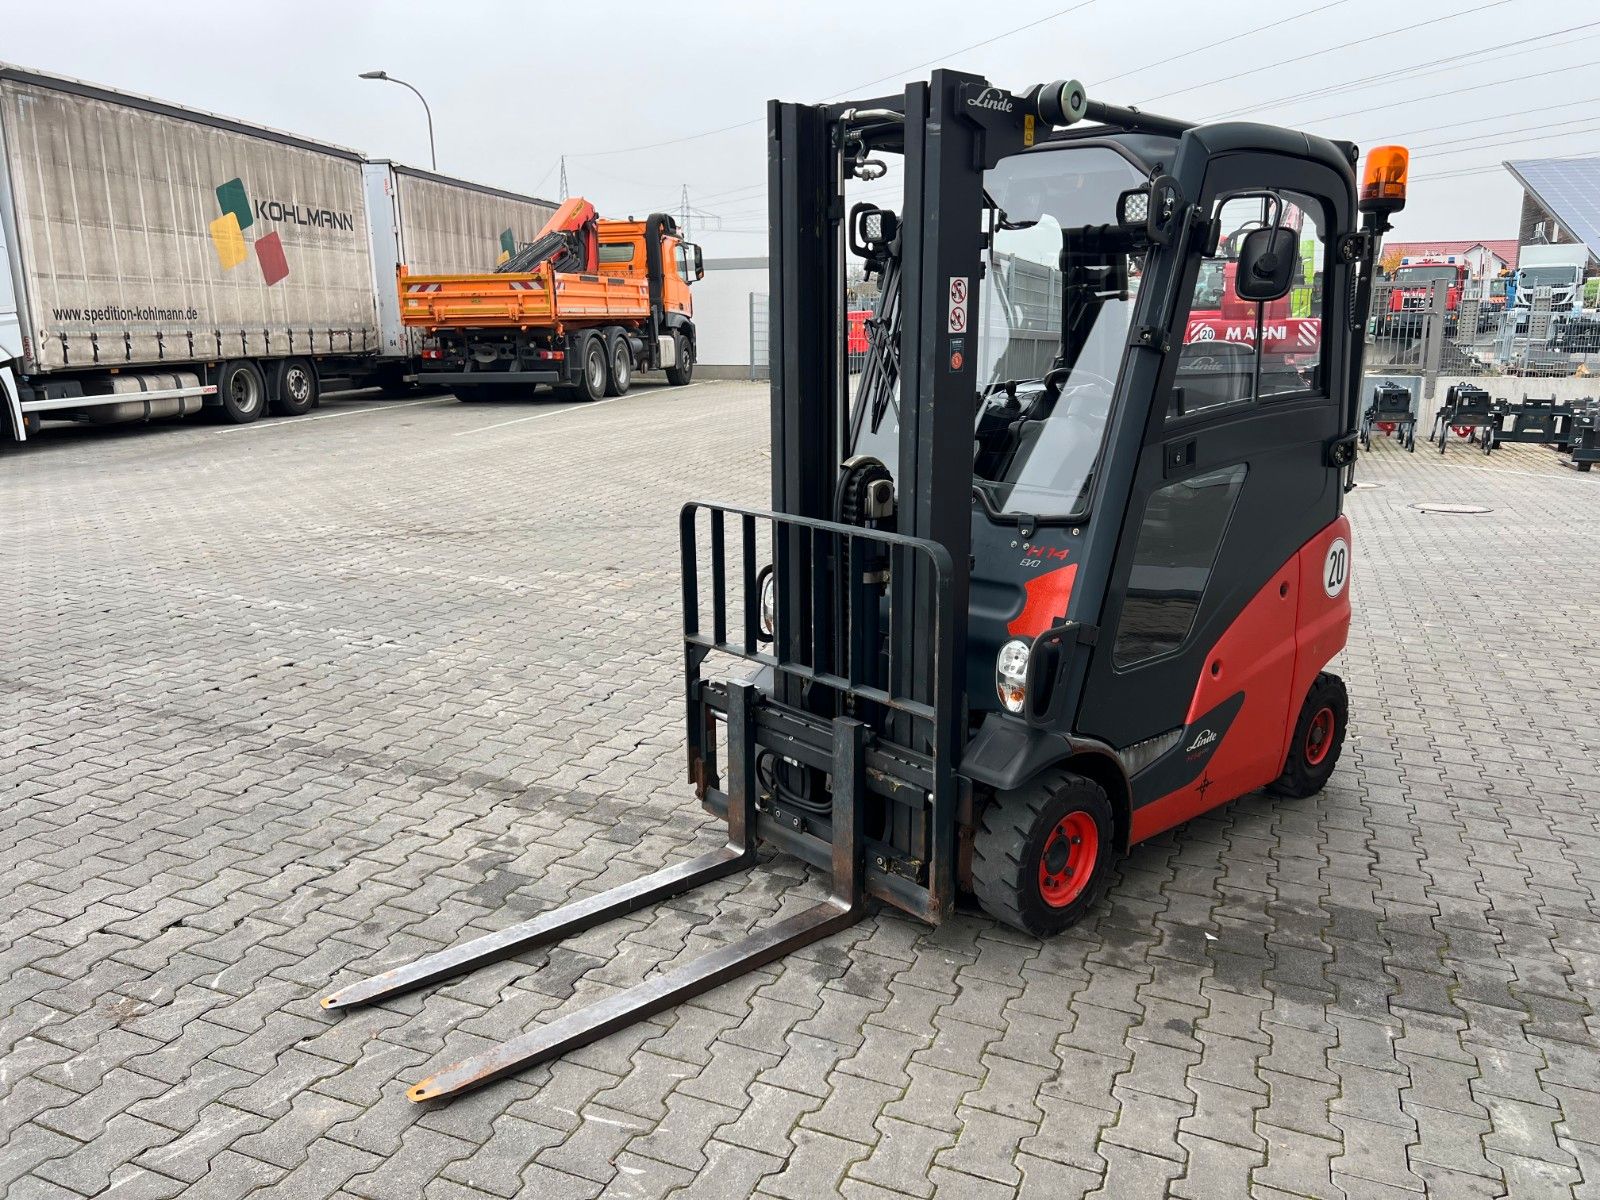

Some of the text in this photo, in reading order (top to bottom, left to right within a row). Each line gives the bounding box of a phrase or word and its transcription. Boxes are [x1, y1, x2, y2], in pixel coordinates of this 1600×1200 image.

[967, 87, 1013, 113] Linde
[254, 199, 354, 232] KOHLMANN
[52, 305, 198, 324] www.spedition-kohlmann.de
[1201, 329, 1214, 340] 20
[1225, 325, 1287, 340] MAGNI
[1026, 544, 1070, 560] H14
[1019, 558, 1041, 568] EVO
[1327, 548, 1345, 588] 20
[1186, 729, 1217, 752] Linde
